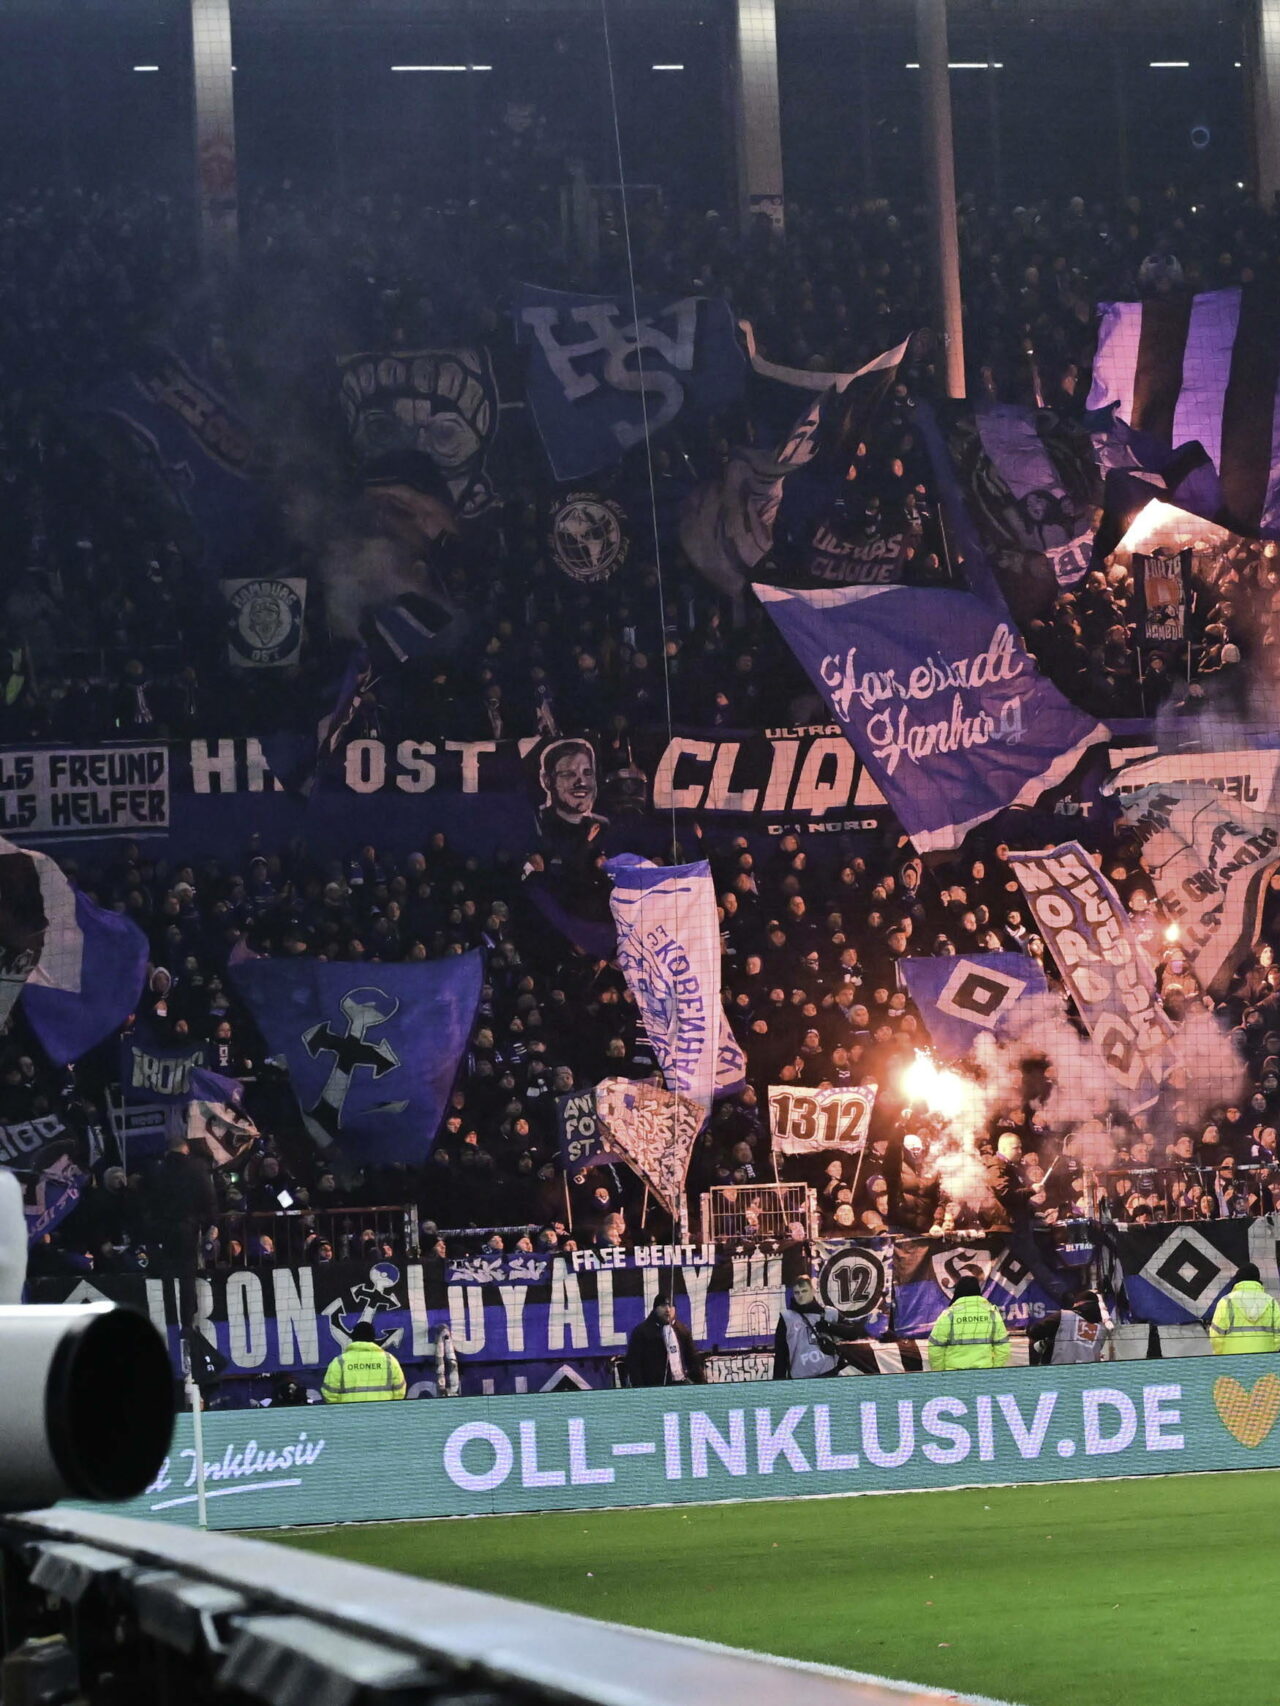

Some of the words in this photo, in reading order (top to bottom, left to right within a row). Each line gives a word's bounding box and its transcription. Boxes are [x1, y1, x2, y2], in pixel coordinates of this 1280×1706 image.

[50, 752, 164, 787] FREUND
[50, 790, 166, 826] HELFER
[808, 818, 878, 833] NORD
[770, 1092, 869, 1144] 1312
[571, 1246, 627, 1271] FREE
[832, 1264, 872, 1305] 12
[956, 1314, 989, 1324] ORDNER
[347, 1362, 382, 1371] ORDNER
[442, 1384, 1186, 1492] OLL-INKLUSIV.DE
